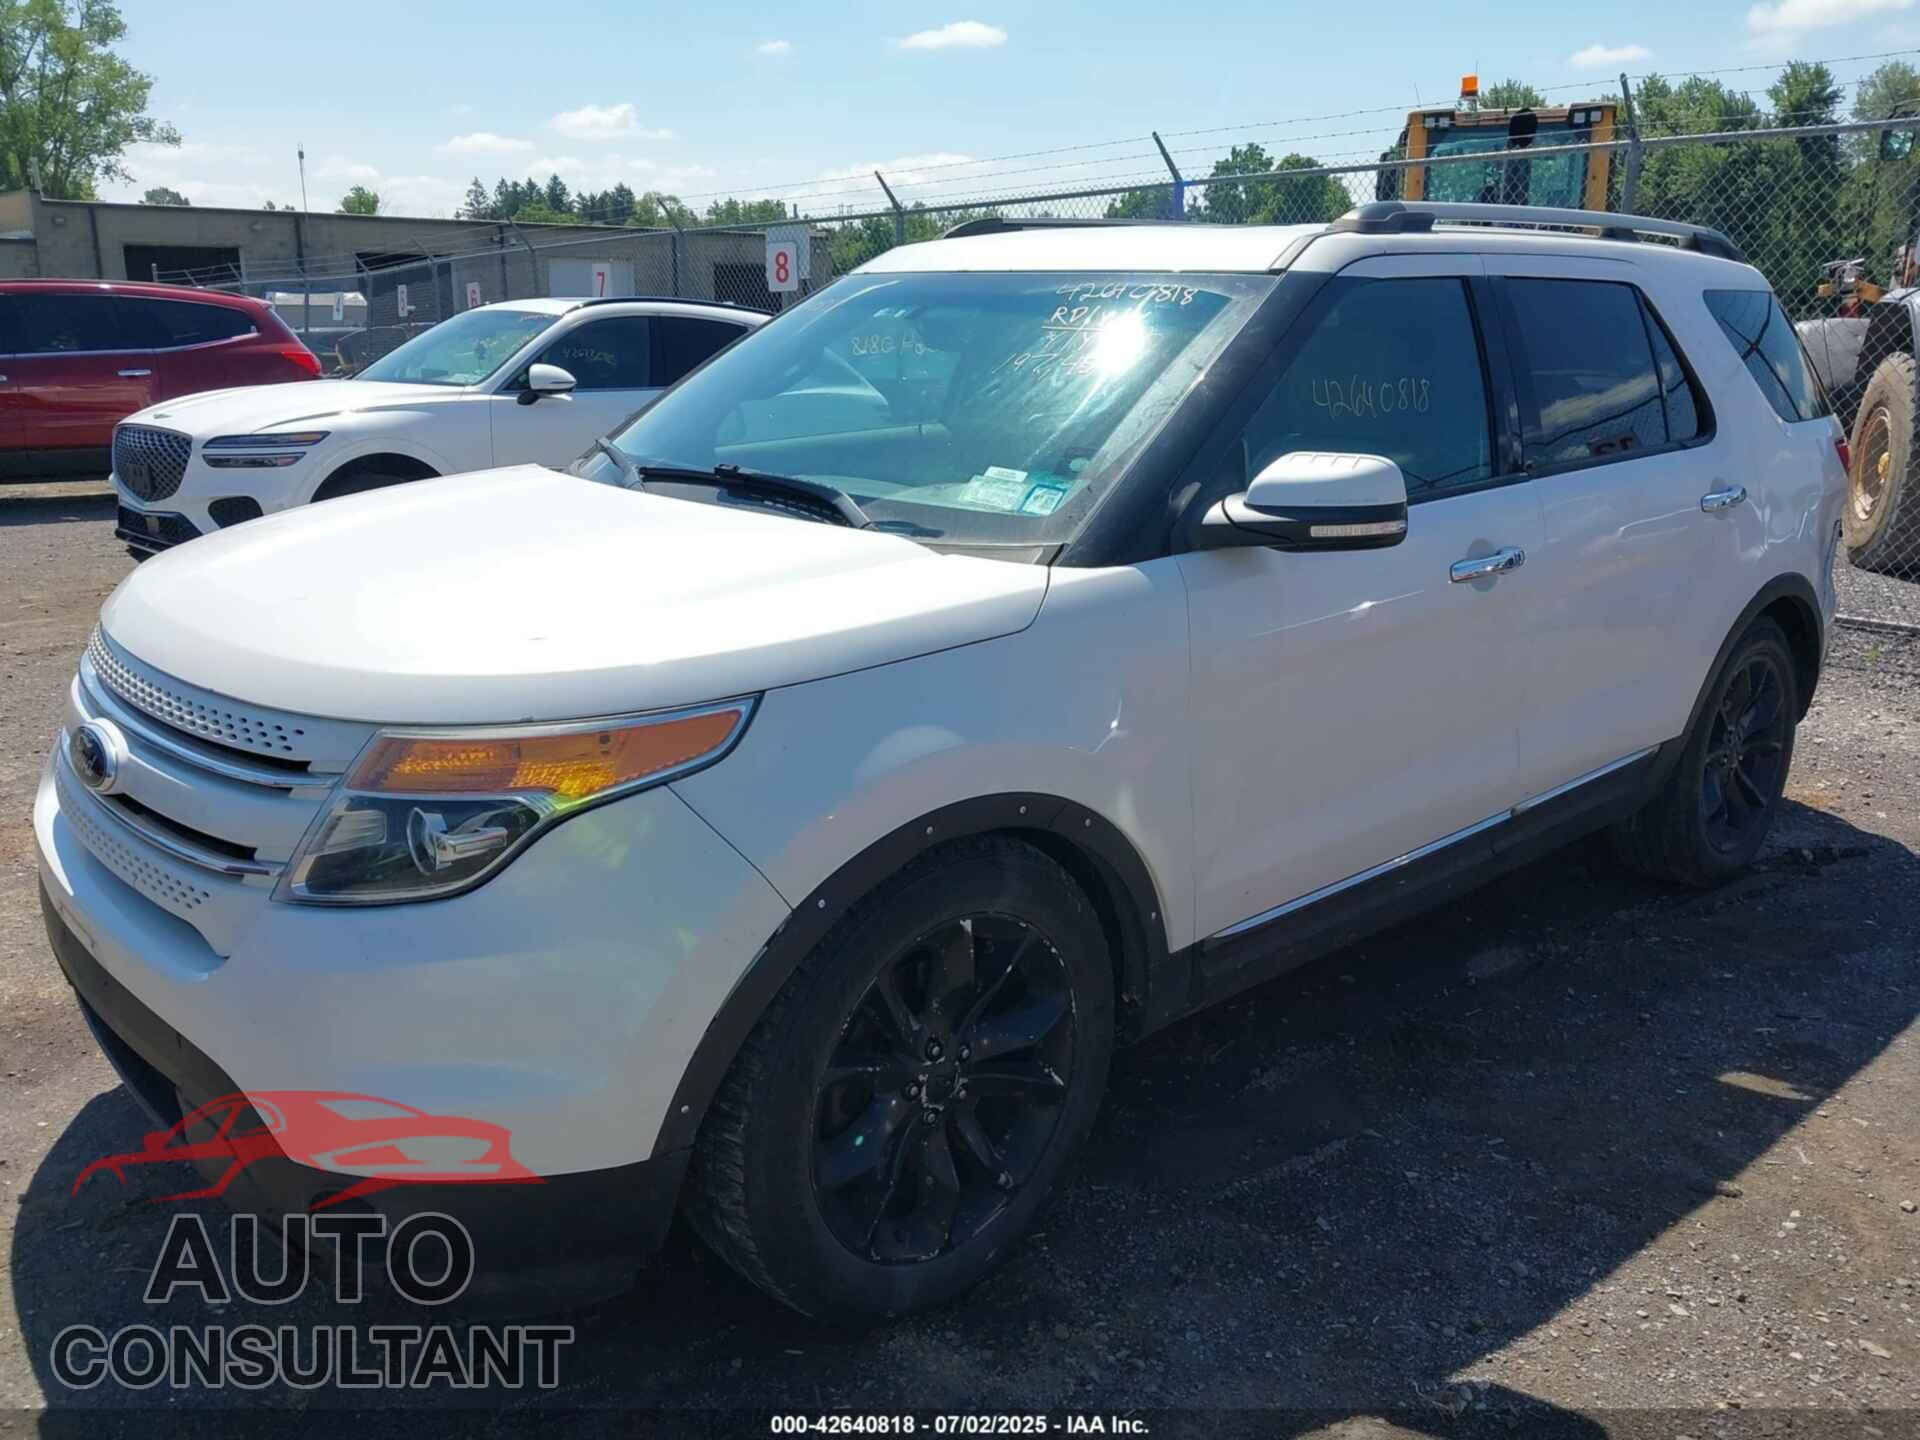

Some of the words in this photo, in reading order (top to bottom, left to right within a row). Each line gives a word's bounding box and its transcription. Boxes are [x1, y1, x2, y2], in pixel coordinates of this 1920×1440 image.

[596, 271, 605, 297] 7
[775, 251, 790, 284] 8
[1311, 374, 1430, 420] 42640818
